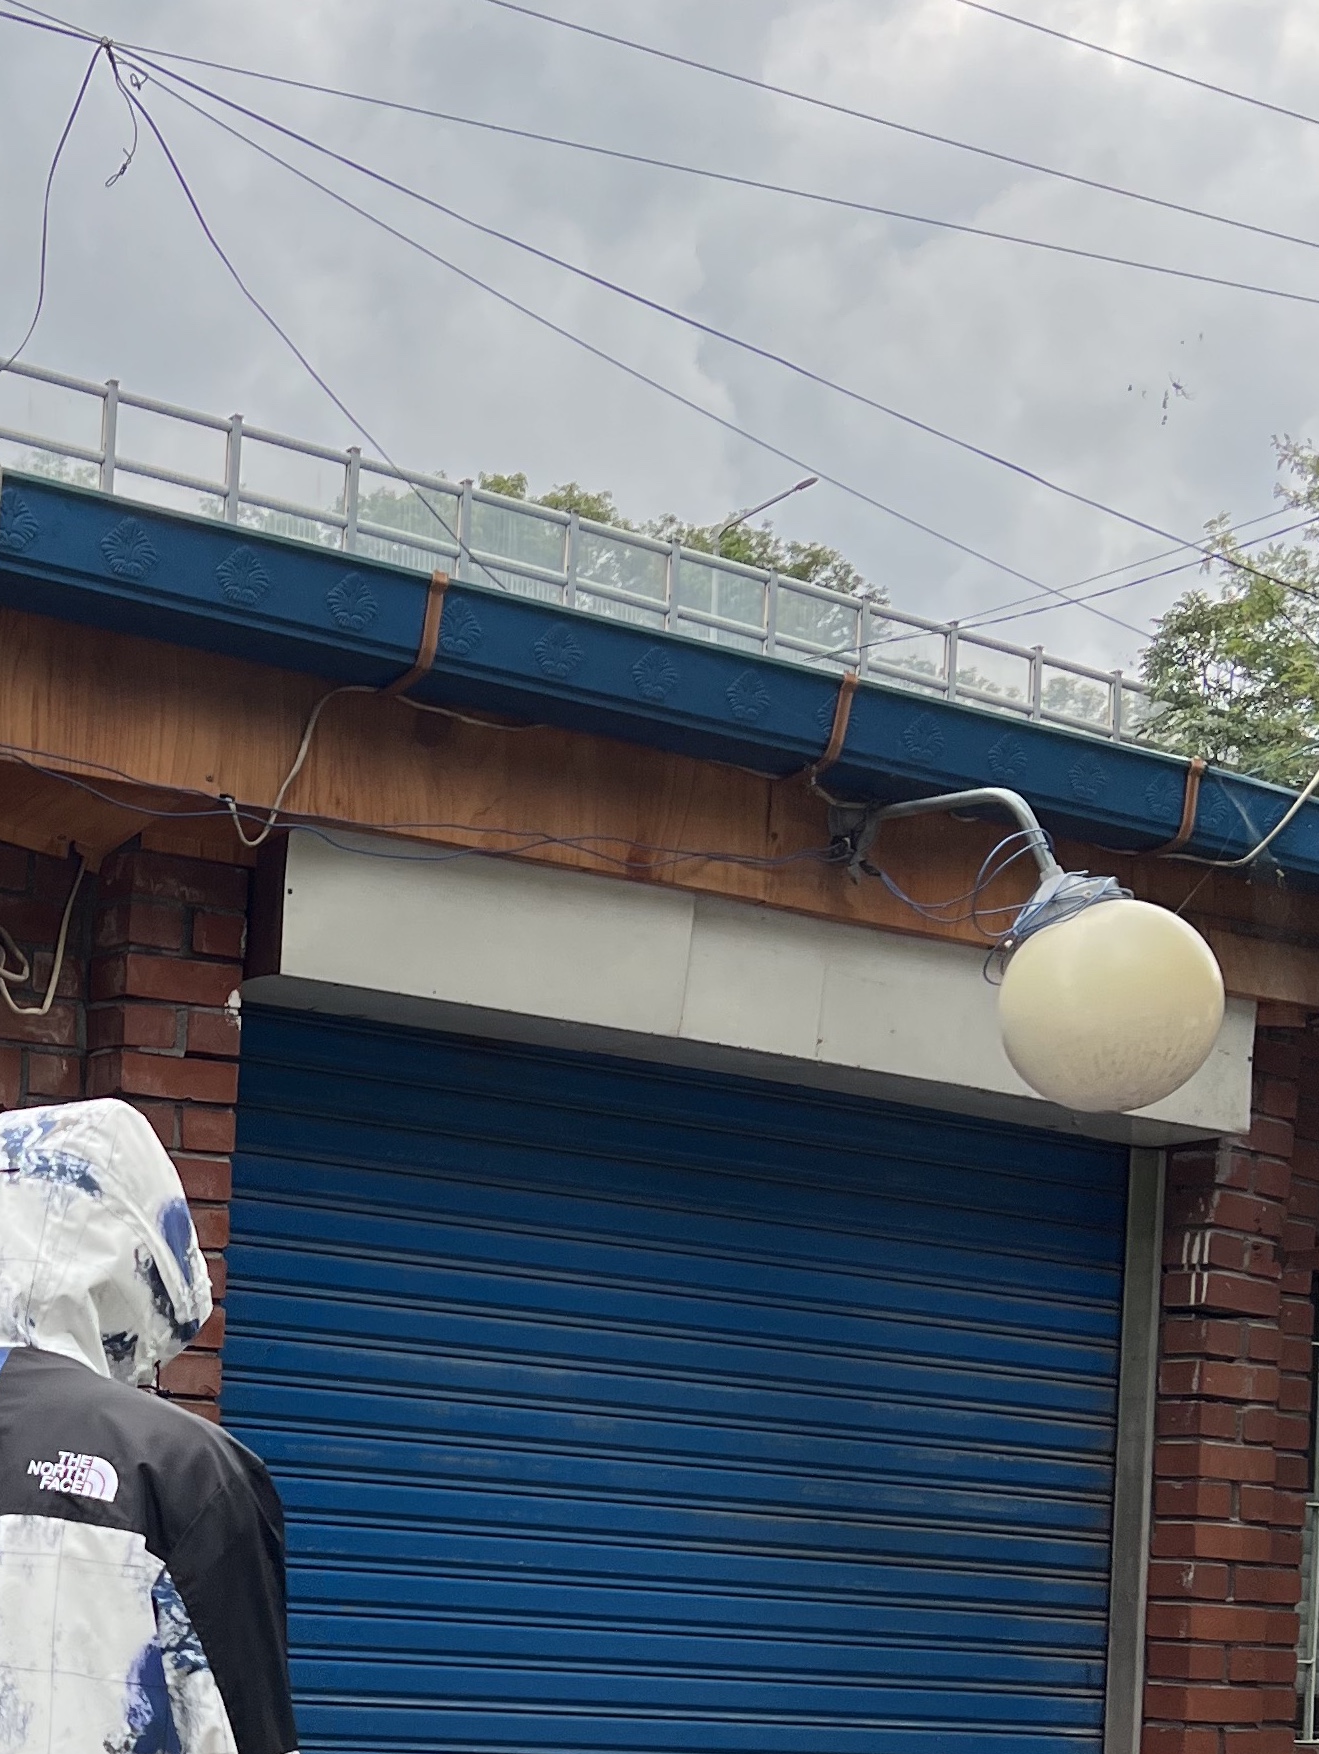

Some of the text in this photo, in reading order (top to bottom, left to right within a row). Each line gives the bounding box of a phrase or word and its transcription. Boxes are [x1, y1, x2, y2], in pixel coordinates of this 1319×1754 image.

[59, 1451, 93, 1467] THE
[27, 1460, 89, 1481] NORTH
[40, 1475, 84, 1495] FACE
